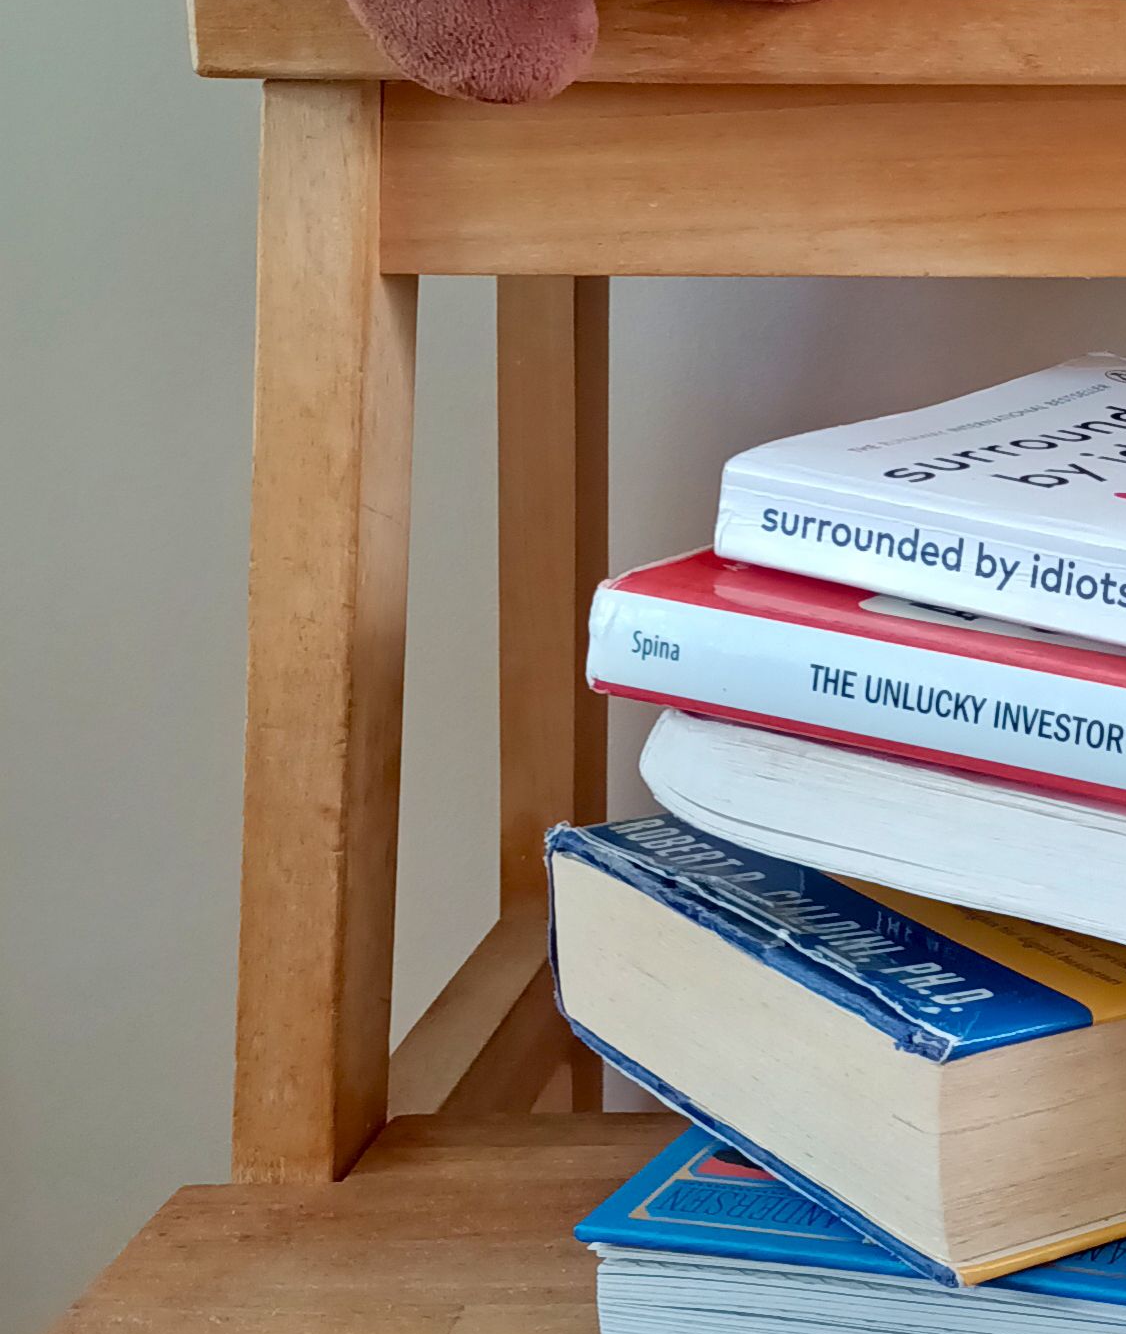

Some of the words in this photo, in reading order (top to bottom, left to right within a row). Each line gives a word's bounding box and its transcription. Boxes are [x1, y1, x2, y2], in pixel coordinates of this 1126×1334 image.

[990, 462, 1108, 489] by
[761, 506, 965, 573] surrounded
[974, 542, 1021, 592] by
[630, 629, 682, 663] Spina
[809, 662, 857, 700] THE
[864, 674, 988, 725] UNLUCKY
[607, 818, 745, 871] ROBERT
[879, 962, 995, 1014] PH.D.
